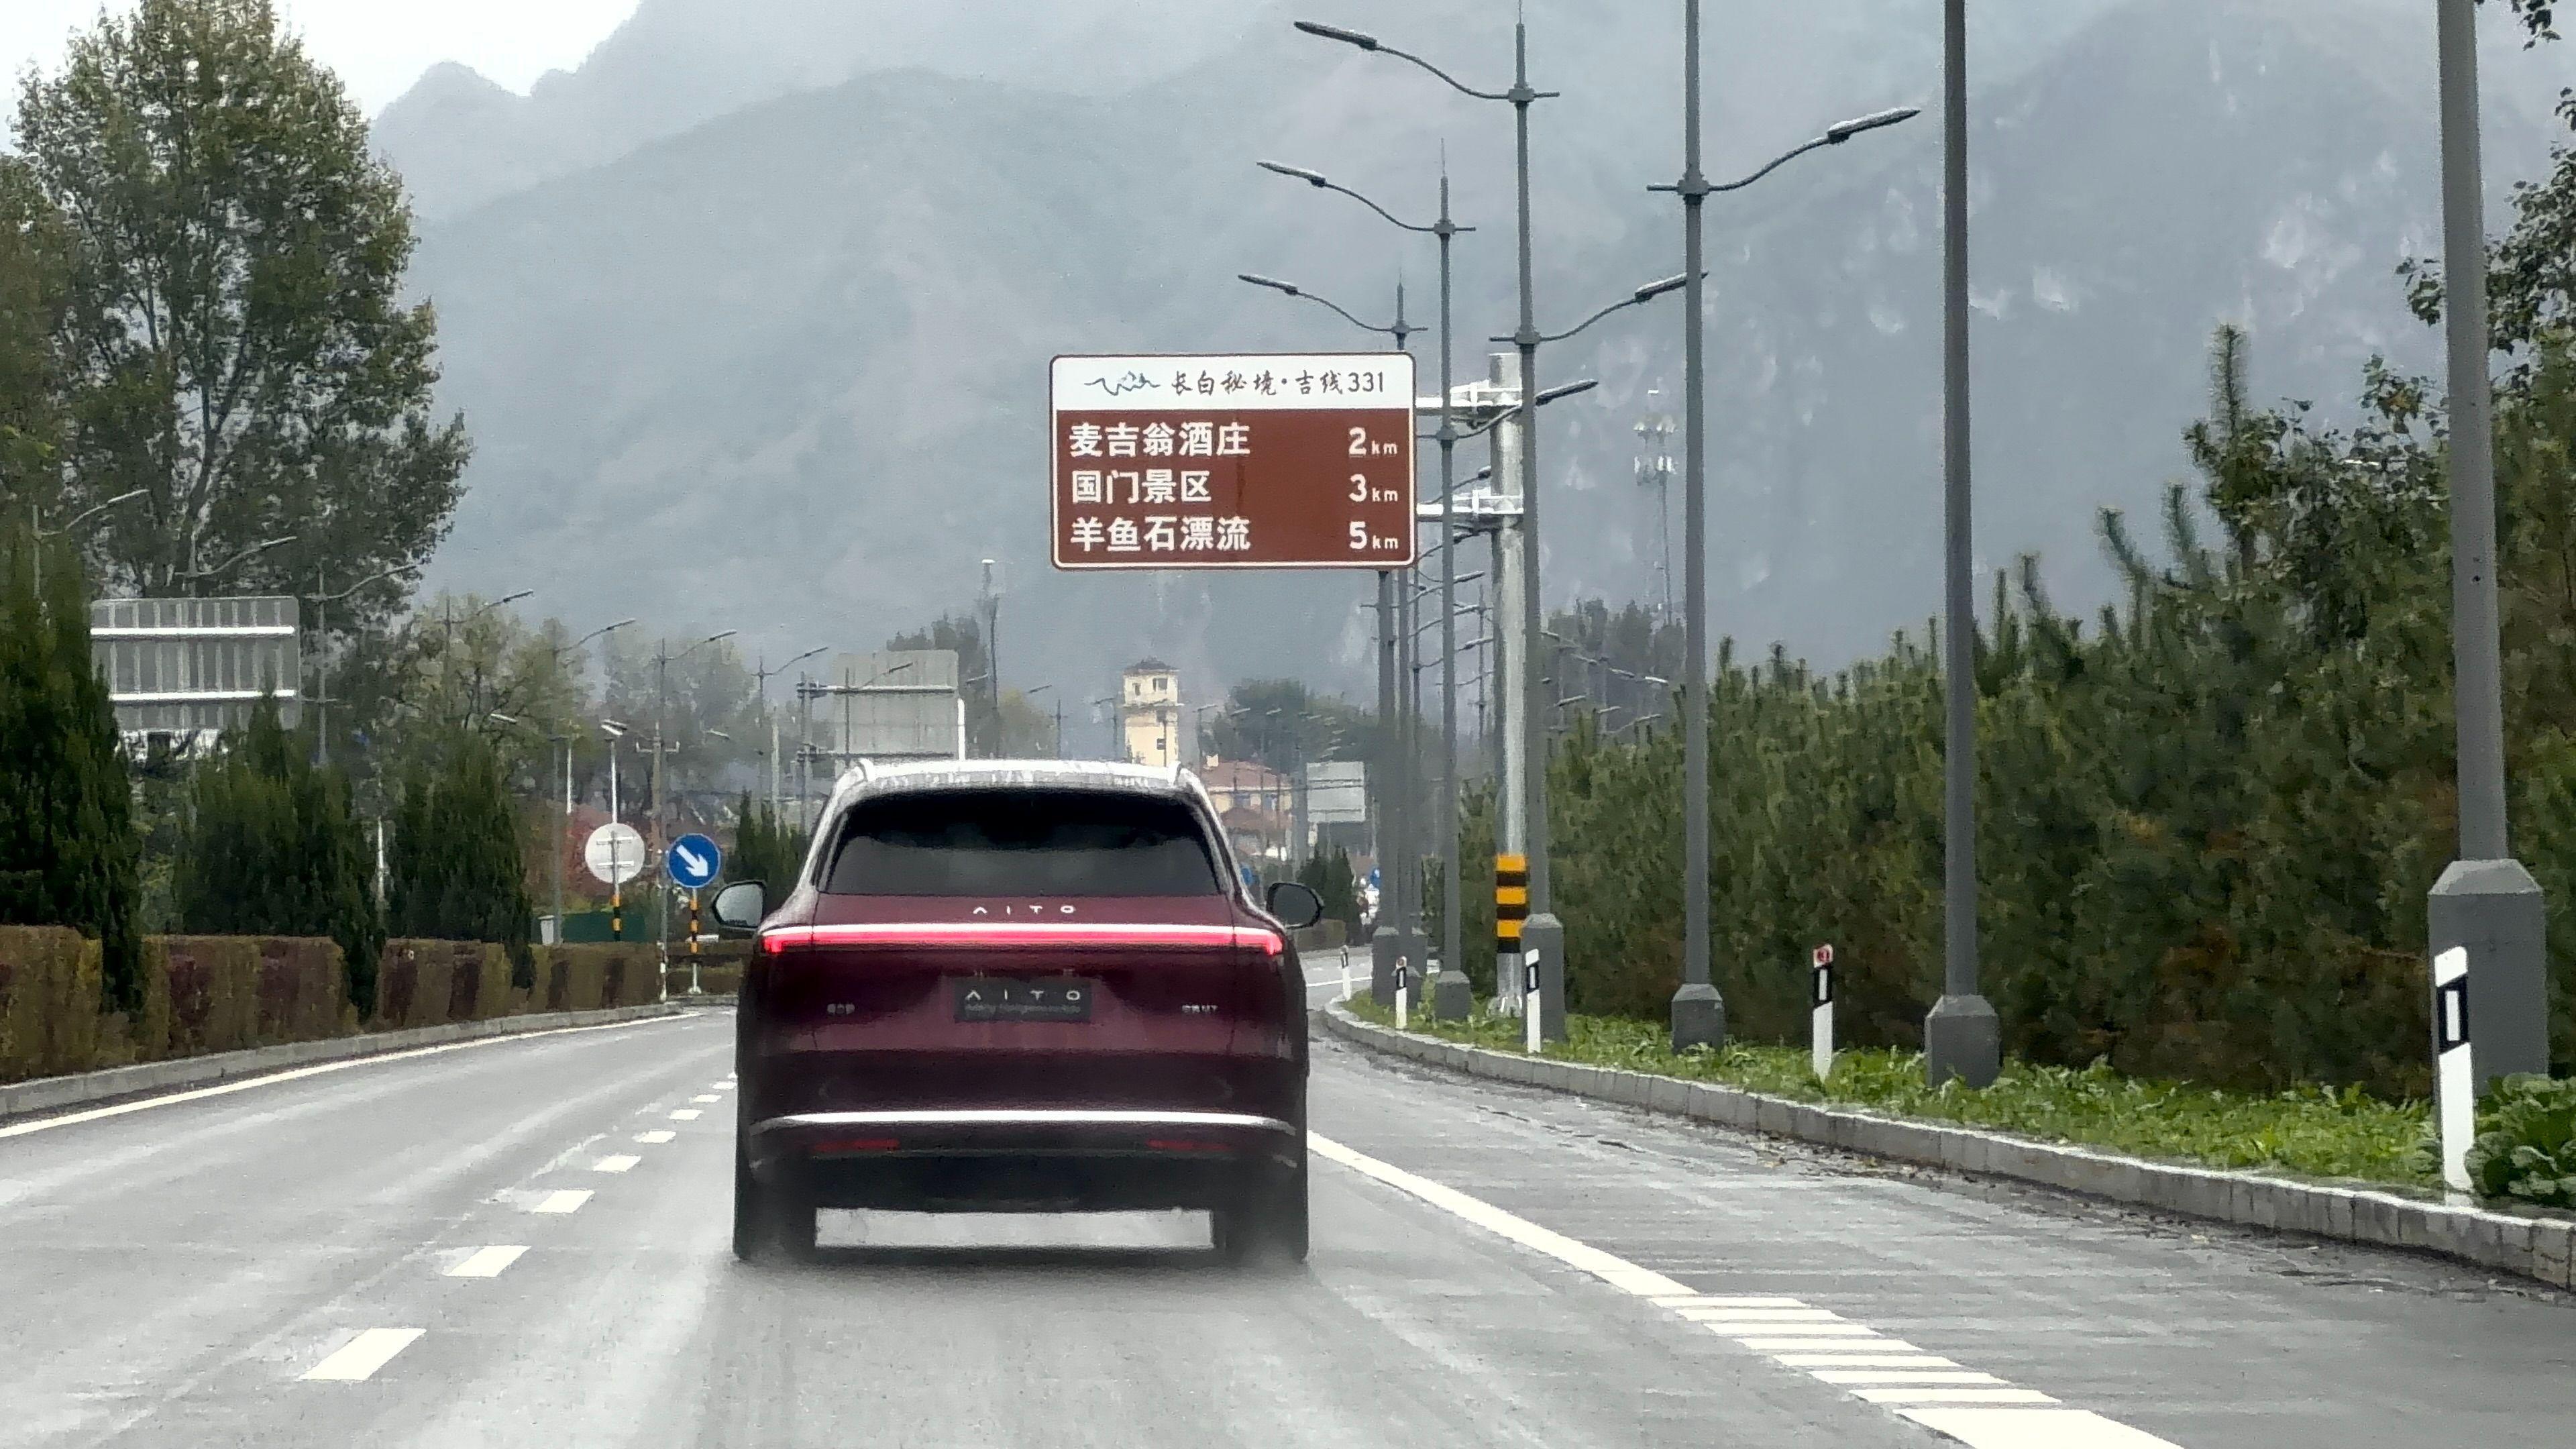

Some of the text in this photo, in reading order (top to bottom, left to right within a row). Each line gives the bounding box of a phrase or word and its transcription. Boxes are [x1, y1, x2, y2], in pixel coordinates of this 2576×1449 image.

[1069, 422, 1250, 457] 麦吉翁酒庄
[1072, 469, 1212, 504] 国门景区
[1070, 516, 1251, 551] 羊鱼石漂流
[973, 905, 1075, 915] AITO
[965, 989, 1081, 1001] AITO
